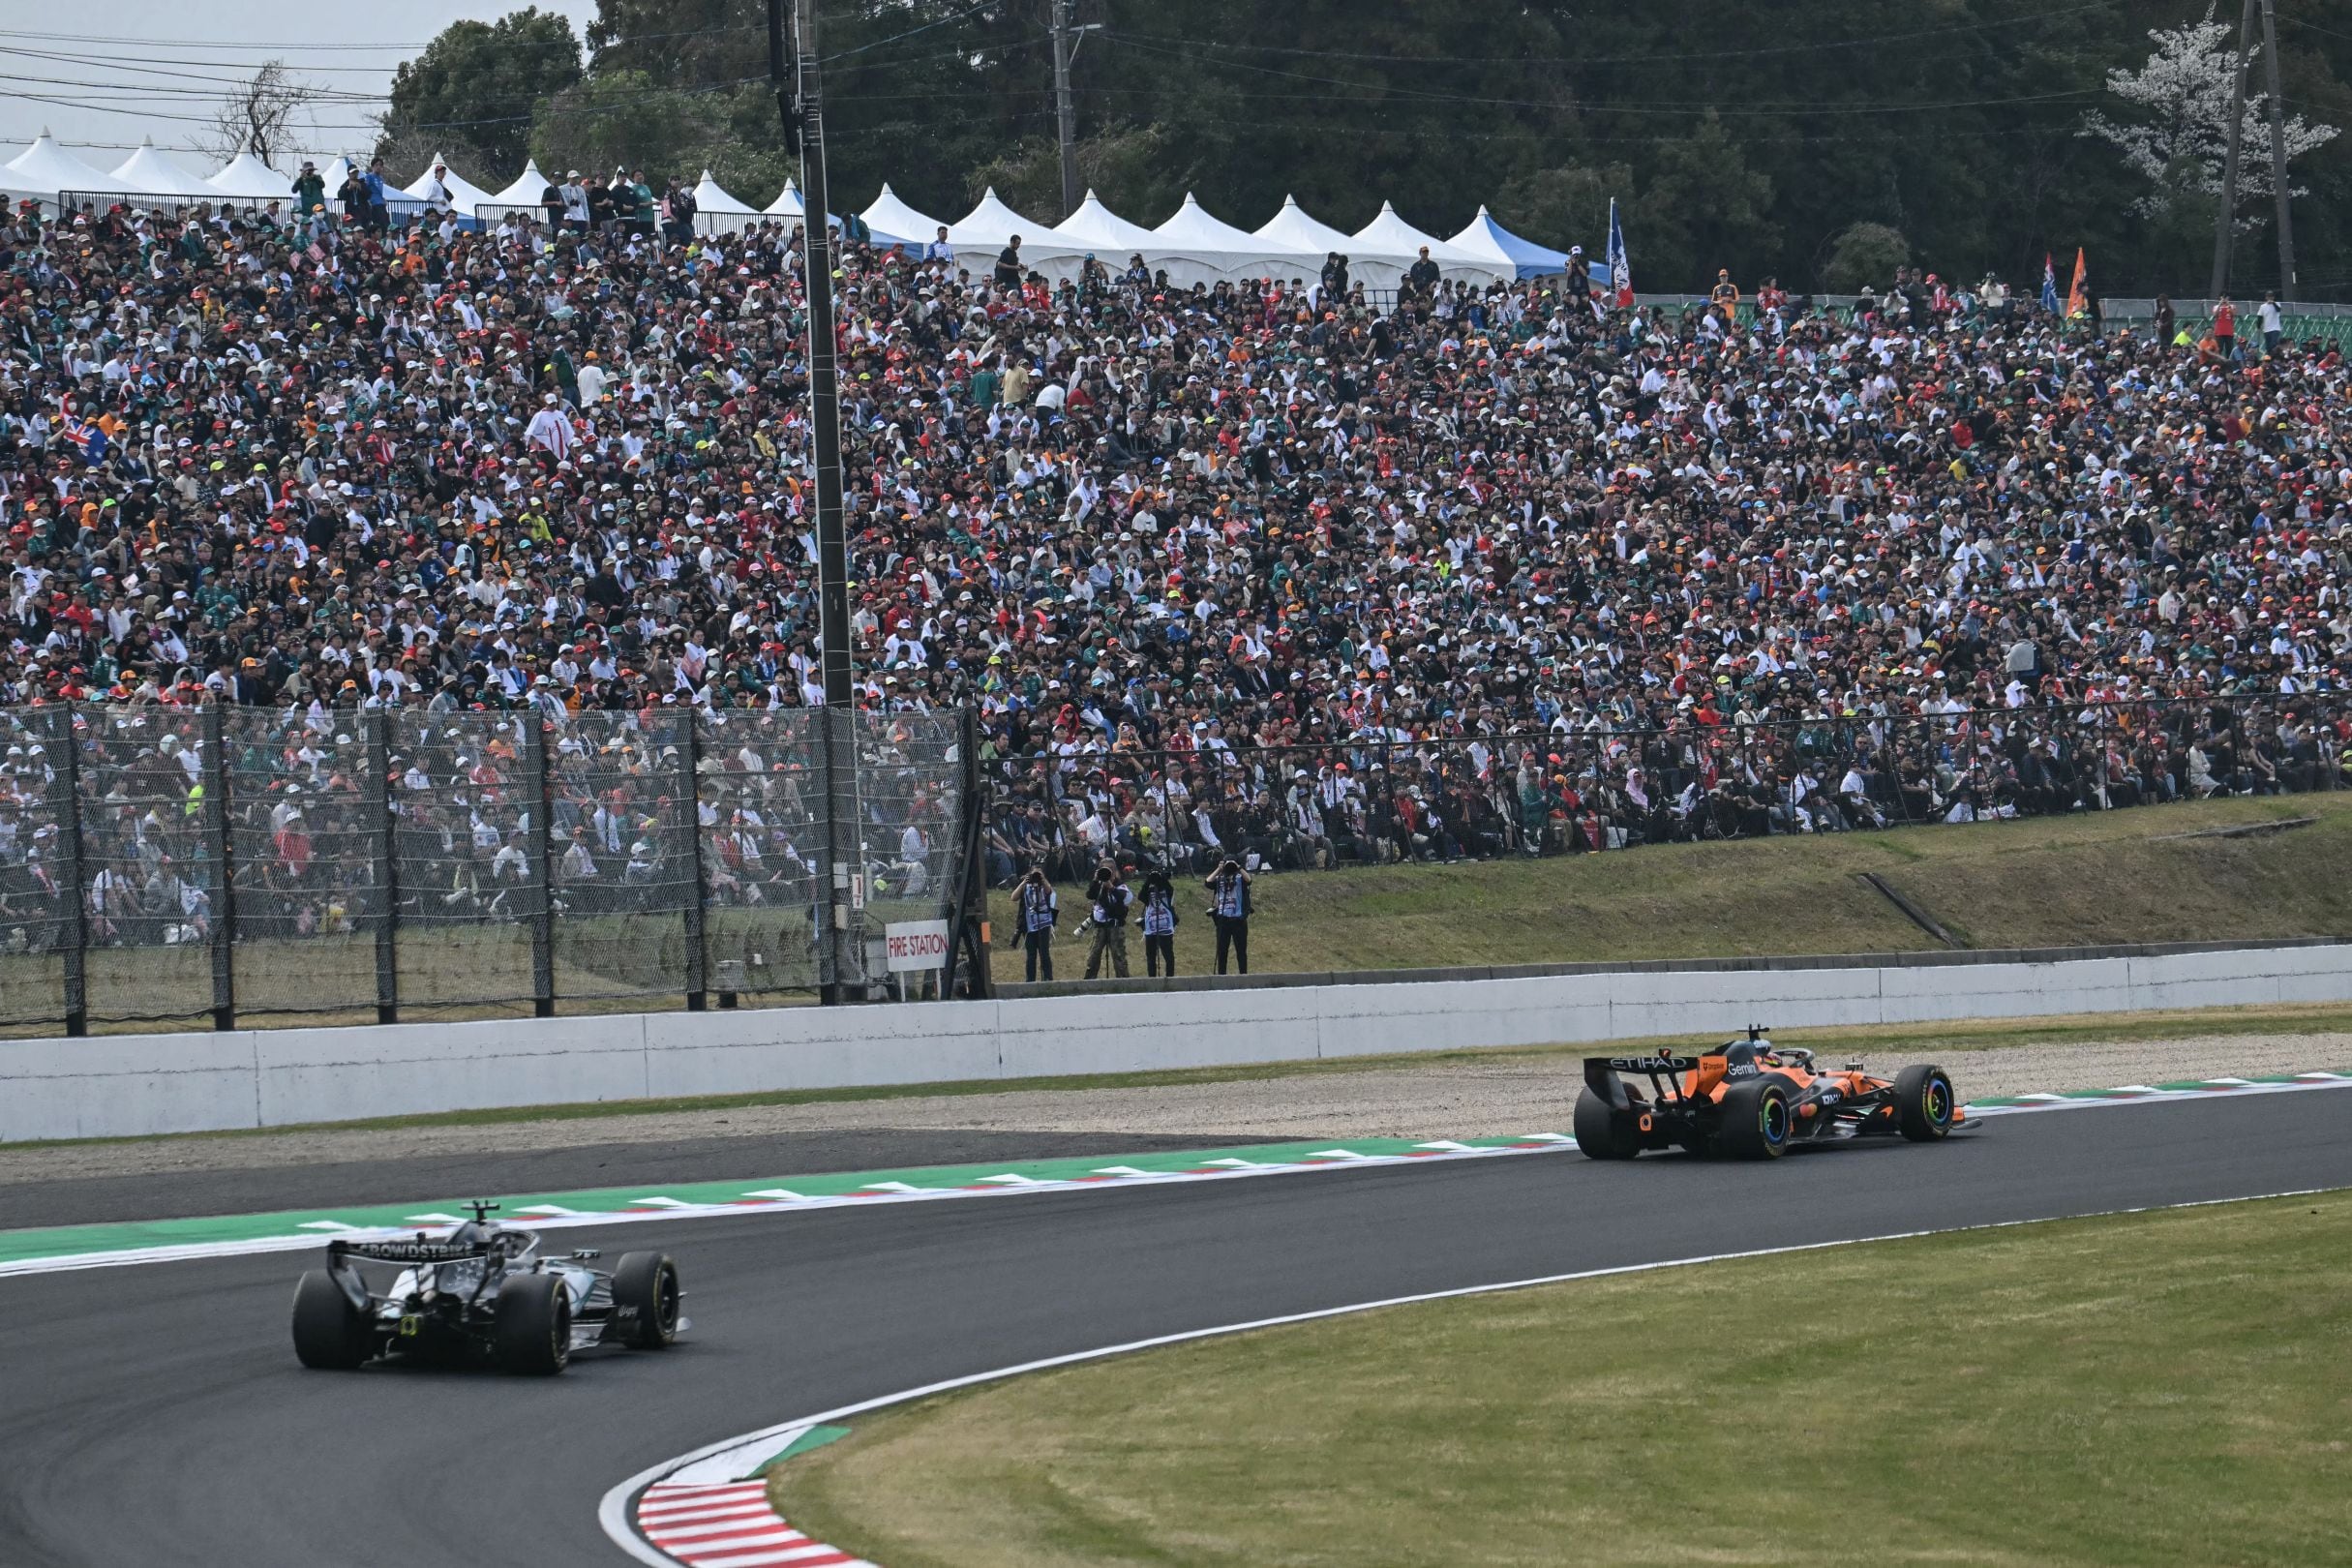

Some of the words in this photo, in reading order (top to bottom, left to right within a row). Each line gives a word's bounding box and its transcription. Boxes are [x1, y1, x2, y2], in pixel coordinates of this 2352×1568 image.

[888, 936, 908, 957] FIRE
[910, 933, 950, 956] STATION
[1610, 1057, 1687, 1070] ETIHAD
[1728, 1061, 1757, 1076] Gemini
[358, 1243, 473, 1258] CROWDSTRIKE
